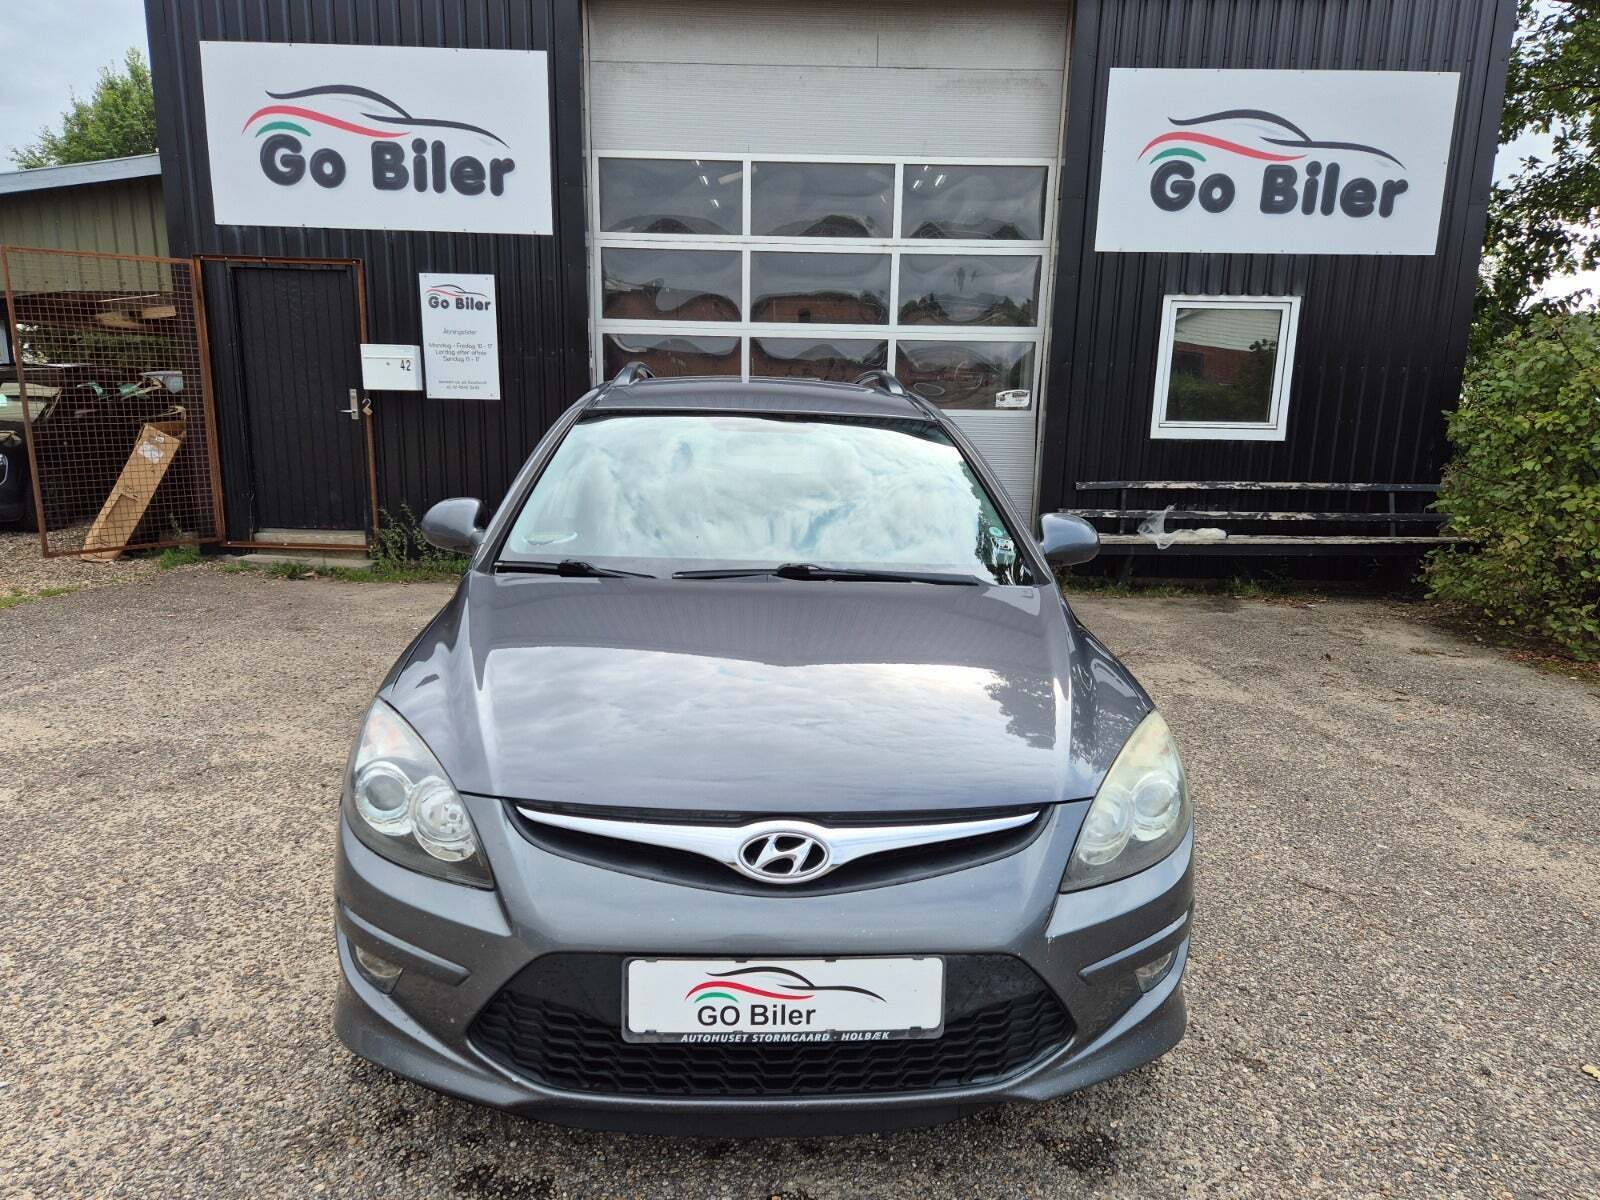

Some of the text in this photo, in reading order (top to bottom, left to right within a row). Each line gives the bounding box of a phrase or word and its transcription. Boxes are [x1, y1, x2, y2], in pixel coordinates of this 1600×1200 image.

[260, 133, 515, 196] Go Biler
[1150, 160, 1409, 218] Go Biler
[428, 295, 491, 311] Go Biler
[400, 359, 411, 371] 42
[697, 1004, 816, 1026] GO Biler
[680, 1034, 749, 1043] AUTOHUSET
[752, 1033, 830, 1042] STORMGAARD
[841, 1031, 890, 1041] HOLBÆK
